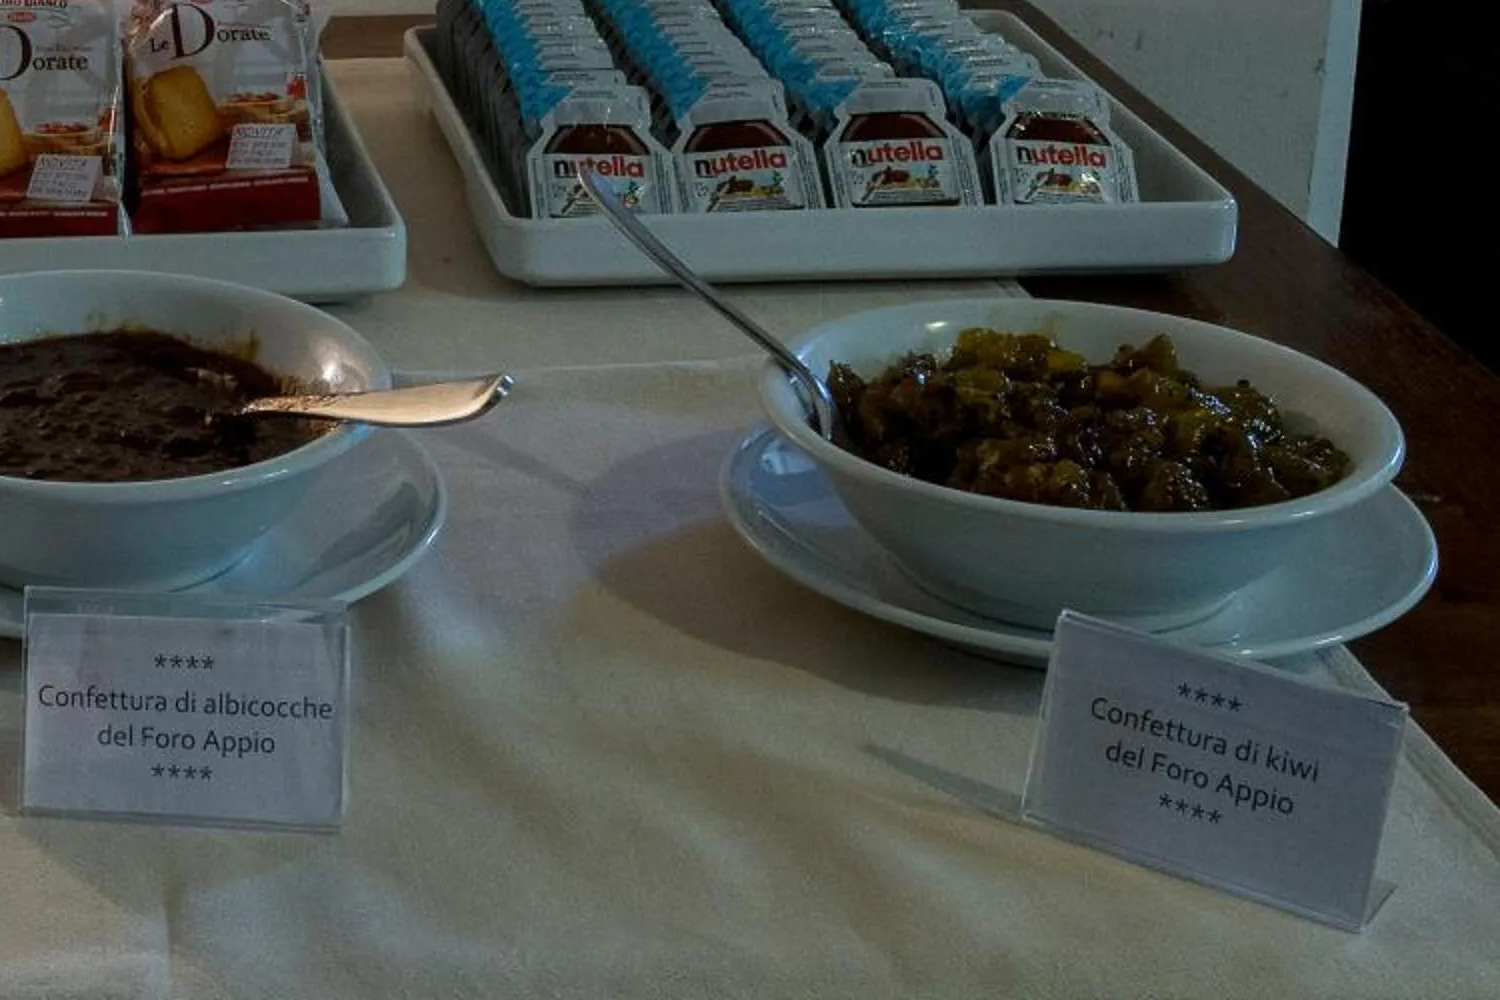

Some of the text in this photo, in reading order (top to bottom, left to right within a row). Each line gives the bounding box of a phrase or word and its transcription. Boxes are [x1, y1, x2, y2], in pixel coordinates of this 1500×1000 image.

[151, 2, 272, 61] Le Dorate
[694, 150, 788, 178] nutella
[851, 140, 943, 165] nutella
[1016, 145, 1107, 168] nutella
[38, 684, 334, 720] Confettura di albicocche
[97, 724, 276, 759] del Foro Appio
[1091, 696, 1320, 783] Confettura di kiwi
[1105, 741, 1295, 817] del Foro Appio
